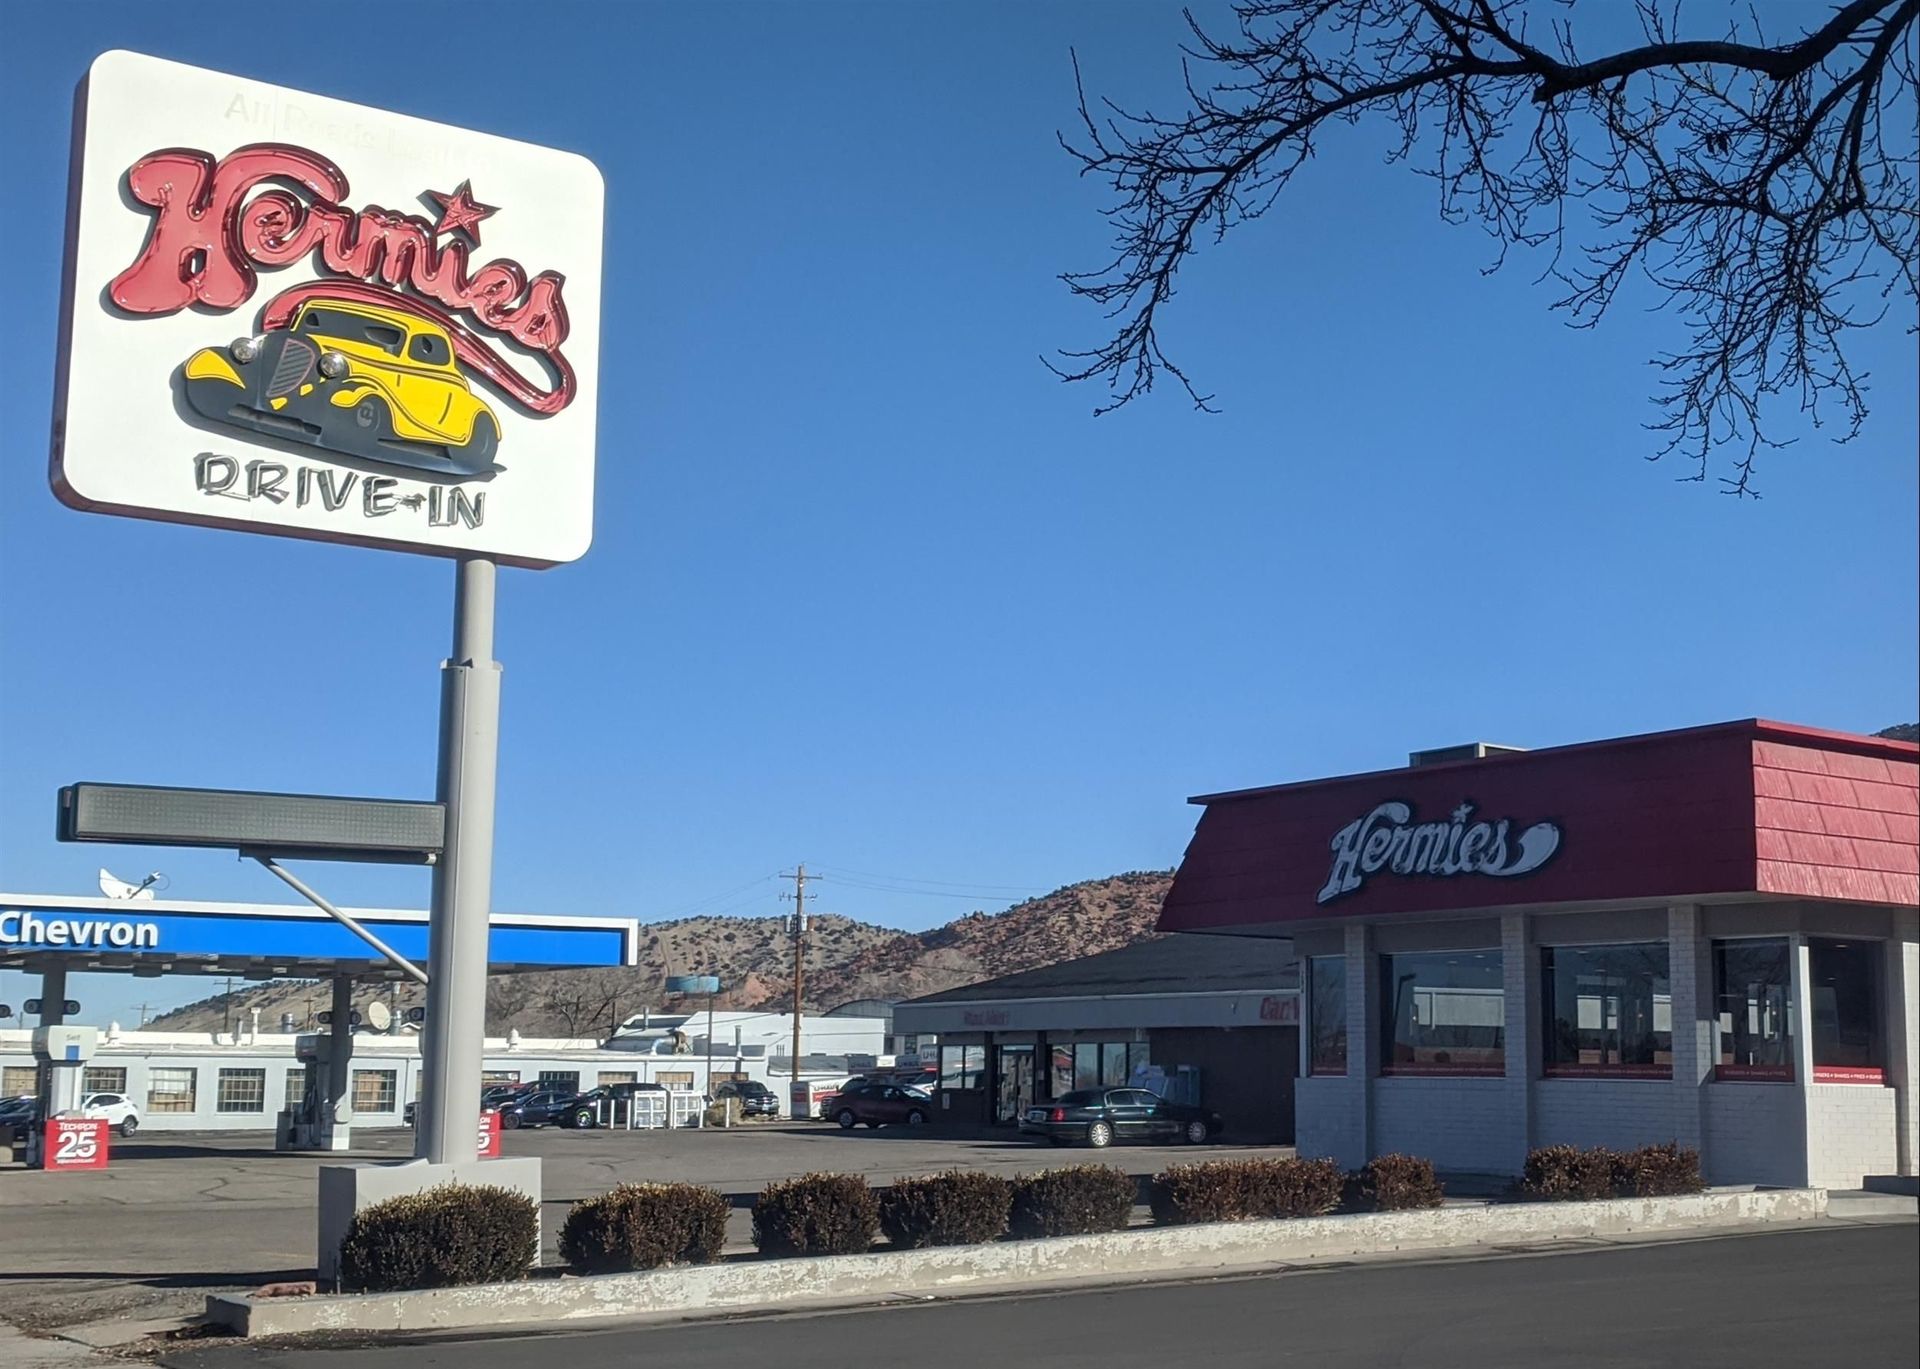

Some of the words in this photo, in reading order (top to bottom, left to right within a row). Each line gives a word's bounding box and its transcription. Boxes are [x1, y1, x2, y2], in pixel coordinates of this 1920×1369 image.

[104, 142, 577, 412] Hermies
[194, 452, 487, 529] DRIVE-IN
[1317, 800, 1560, 904] Hermies
[0, 910, 158, 947] Chevron
[55, 1131, 98, 1159] 25
[59, 1121, 98, 1131] TECHRON
